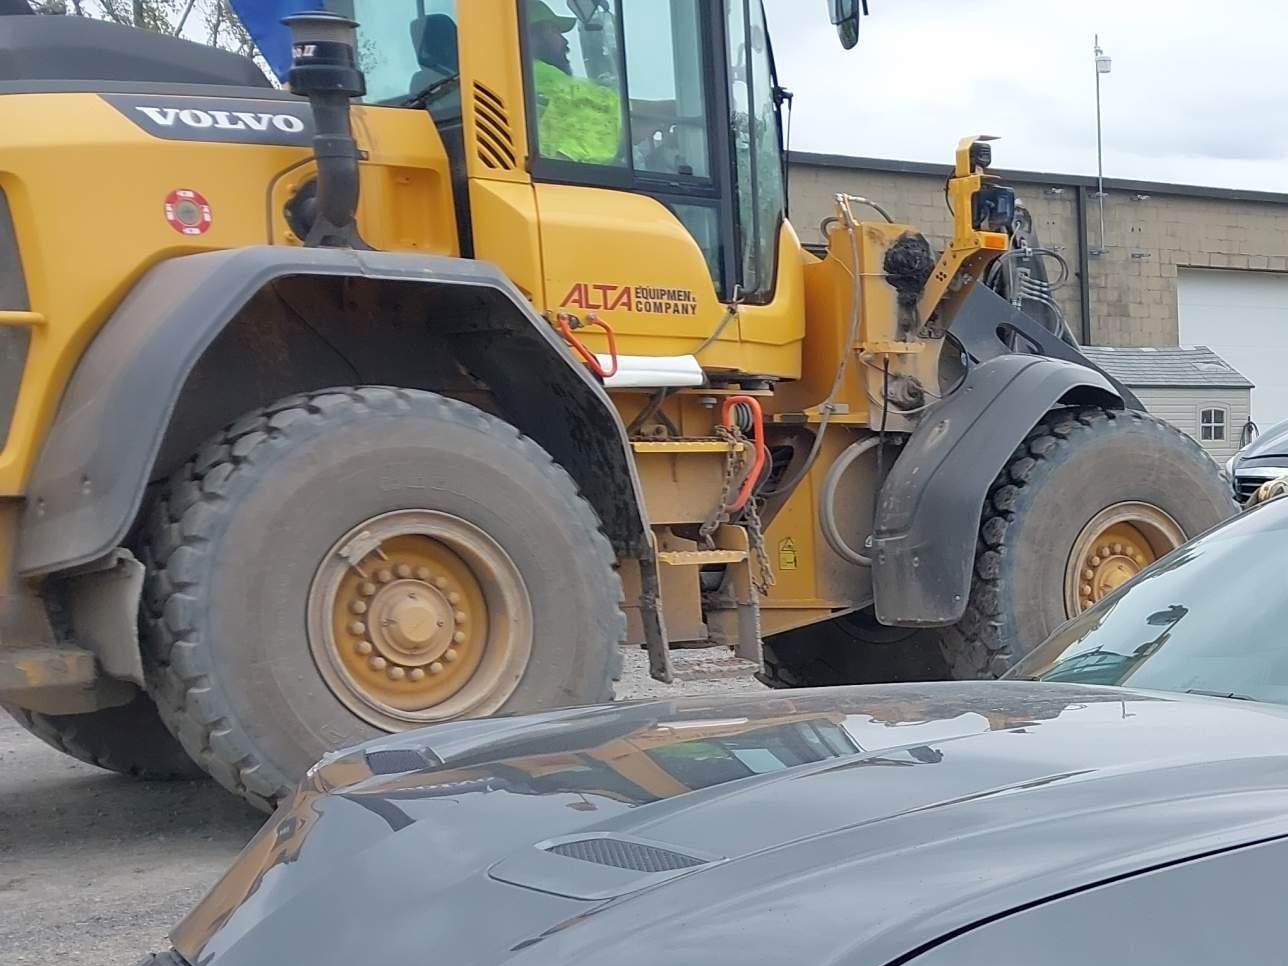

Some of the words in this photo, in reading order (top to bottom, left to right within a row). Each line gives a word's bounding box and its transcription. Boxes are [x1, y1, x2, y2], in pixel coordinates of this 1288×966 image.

[136, 106, 304, 133] VOLVO
[559, 283, 633, 312] ALTA
[635, 286, 697, 303] EQUIPMEN
[635, 300, 698, 316] COMPANY
